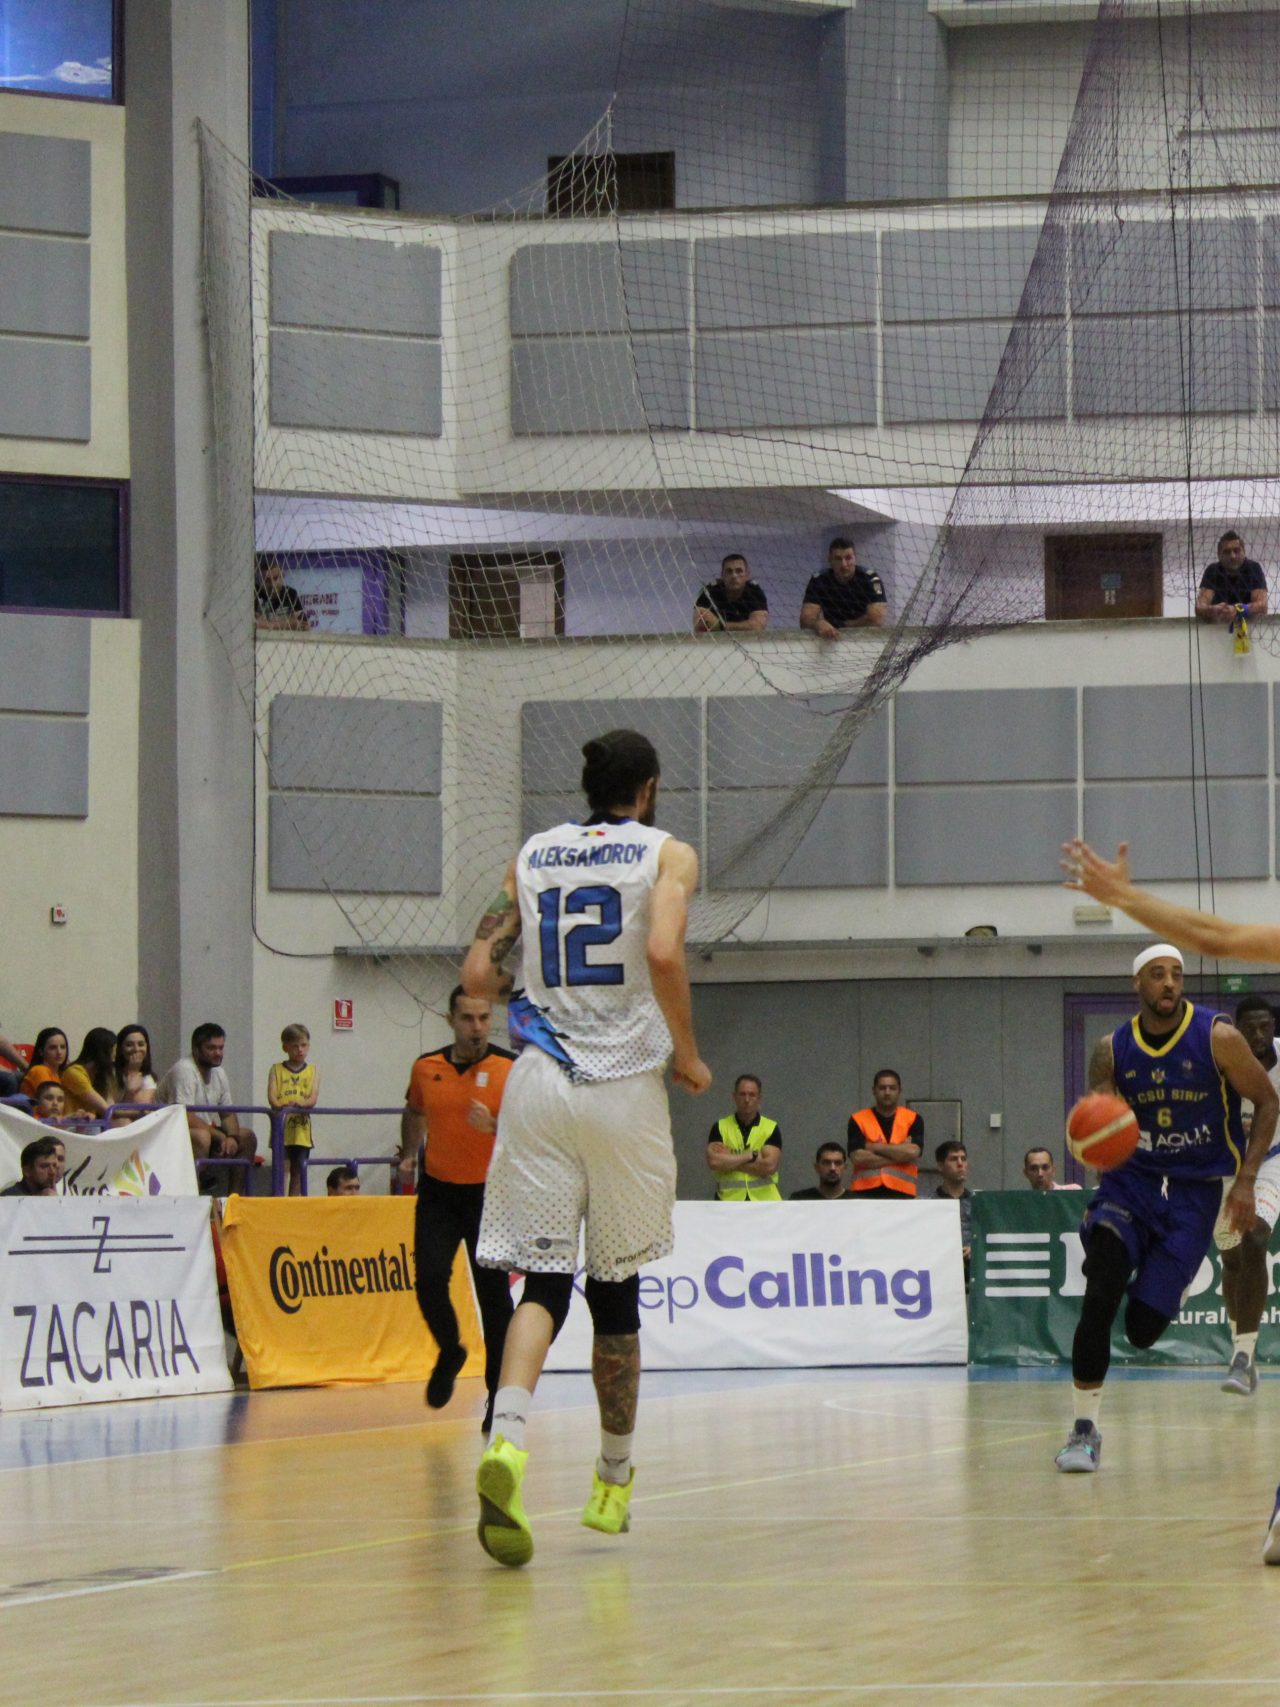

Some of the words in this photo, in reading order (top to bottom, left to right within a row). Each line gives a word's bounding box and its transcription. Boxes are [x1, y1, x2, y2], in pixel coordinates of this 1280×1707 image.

[537, 885, 624, 988] 12
[1157, 1107, 1172, 1128] 6
[269, 1244, 414, 1314] Continental
[13, 1298, 201, 1388] ZACARIA
